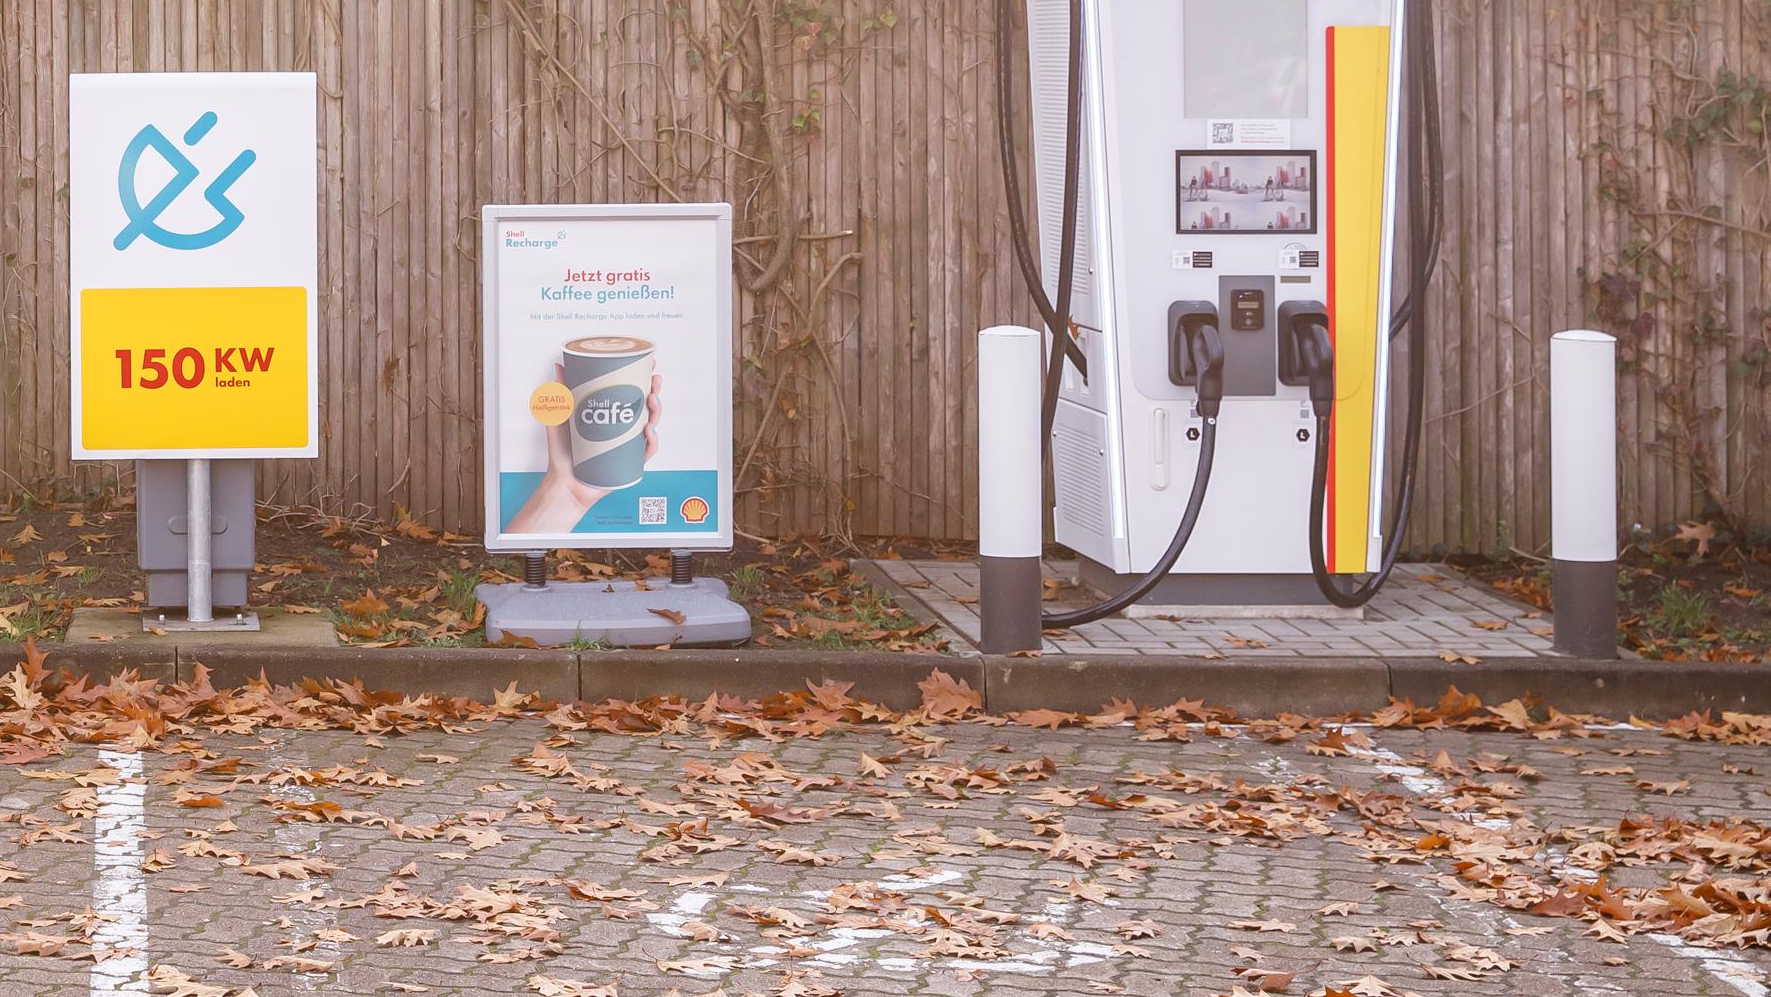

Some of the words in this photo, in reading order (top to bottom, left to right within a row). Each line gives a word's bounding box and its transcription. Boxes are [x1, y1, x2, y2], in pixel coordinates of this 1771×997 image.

[506, 230, 525, 238] Shell
[506, 238, 558, 250] Recharge
[564, 269, 602, 283] Jetzt
[606, 268, 651, 285] gratis
[541, 286, 592, 301] Kaffee
[597, 285, 675, 304] genießen!
[574, 312, 608, 321] Recharge
[609, 312, 625, 321] App
[115, 347, 205, 390] 150
[215, 347, 275, 373] KW
[215, 377, 251, 388] laden
[538, 395, 566, 403] GRATIS
[587, 399, 610, 408] Shell
[581, 402, 634, 424] café
